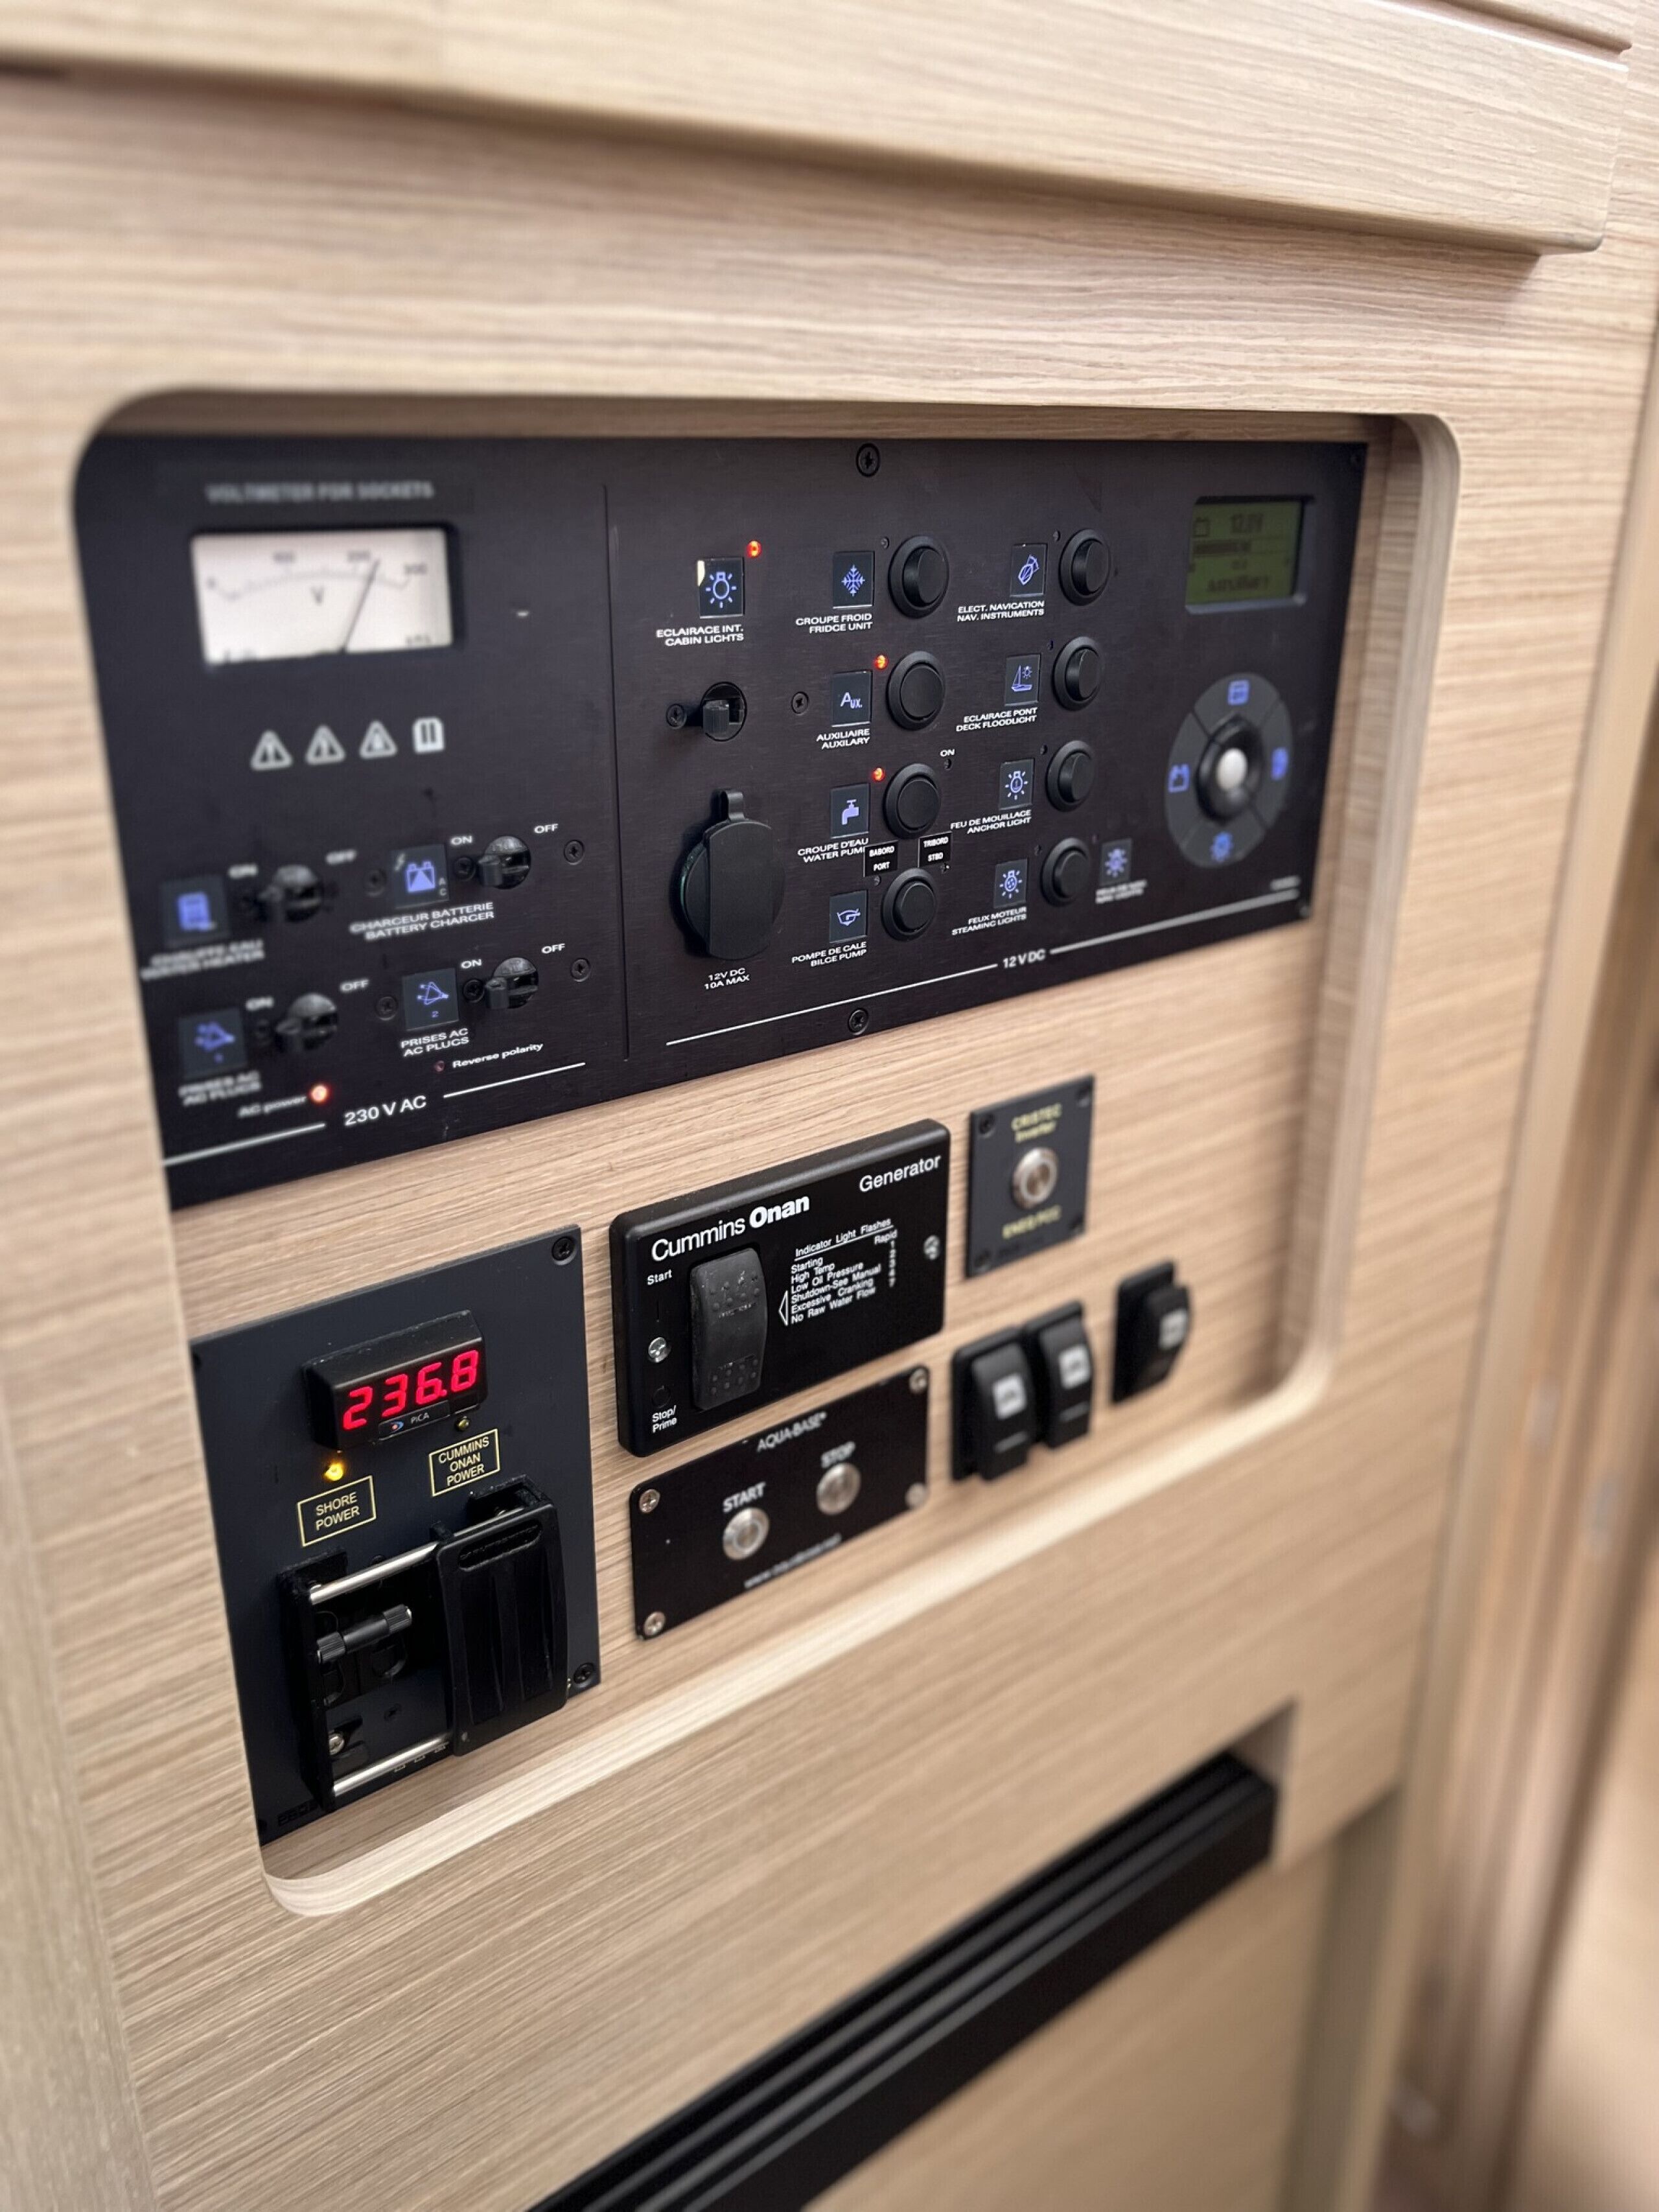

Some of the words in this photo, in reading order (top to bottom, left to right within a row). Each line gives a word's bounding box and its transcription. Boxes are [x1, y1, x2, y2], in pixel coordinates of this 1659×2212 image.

[957, 612, 979, 623] NAV.
[980, 608, 1045, 620] INSTRUMENTS
[958, 603, 988, 614] ELECT.
[841, 613, 872, 622] FROID
[722, 623, 744, 633] INT.
[848, 622, 873, 631] UNIT
[665, 636, 701, 647] CABIN
[704, 633, 745, 644] LIGHTS
[1013, 707, 1038, 717] PONT
[955, 721, 981, 732] DECK
[982, 714, 1038, 729] FLOODLIGHT
[816, 728, 870, 742] AUXILIAIRE
[940, 749, 955, 758] ON
[533, 823, 559, 834] OFF
[950, 820, 966, 830] FEU
[968, 818, 981, 828] DE
[966, 822, 1005, 835] ANCHOR
[1006, 817, 1032, 828] LIGHT
[450, 835, 473, 846] ON
[803, 850, 839, 864] WATER
[873, 861, 890, 872] PORT
[432, 902, 493, 919] BATTERIE
[991, 907, 1027, 920] MOTEUR
[364, 923, 426, 942] BATTERY
[541, 943, 566, 954] OFF
[791, 950, 827, 964] POMPE
[828, 946, 842, 956] DE
[842, 941, 867, 953] CALE
[839, 949, 867, 961] PUMP
[1028, 948, 1046, 964] DC
[461, 959, 482, 970] ON
[708, 970, 729, 981] 12V
[730, 967, 746, 977] DC
[726, 974, 750, 986] MAX
[340, 979, 369, 993] OFF
[400, 1032, 447, 1049] PRISES
[449, 1028, 469, 1038] AC
[402, 1045, 423, 1058] AC
[452, 1053, 499, 1069] Reverse
[502, 1043, 544, 1059] polarity
[263, 1096, 307, 1114] power
[344, 1106, 380, 1127] 230
[399, 1095, 426, 1113] AC
[859, 1154, 942, 1193] Generator
[651, 1217, 746, 1263] Cummins
[748, 1195, 810, 1229] Onan
[795, 1239, 832, 1257] Indicator
[835, 1229, 856, 1244] Light
[860, 1218, 892, 1235] Flashes
[874, 1229, 898, 1245] Rapid
[791, 1257, 824, 1274] Starting
[791, 1271, 810, 1285] High
[813, 1263, 835, 1276] Temp
[852, 1263, 882, 1282] Manual
[647, 1269, 673, 1286] Start
[791, 1281, 809, 1295] Low
[811, 1275, 824, 1286] Oil
[826, 1262, 864, 1281] Pressure
[791, 1294, 831, 1314] Excessive
[837, 1277, 874, 1297] Cranking
[791, 1313, 804, 1325] No
[807, 1305, 826, 1318] Raw
[829, 1295, 853, 1310] Water
[856, 1286, 877, 1300] Flow
[343, 1349, 480, 1432] 236.8
[410, 1412, 430, 1425] PICA
[651, 1404, 677, 1423] Stop/
[652, 1415, 678, 1434] Prime
[437, 1436, 491, 1465] CUMMINS
[821, 1441, 856, 1468] STOP
[450, 1452, 481, 1473] ONAN
[447, 1463, 485, 1487] POWER
[316, 1491, 357, 1517] SHORE
[723, 1482, 766, 1513] START
[315, 1506, 360, 1531] POWER
